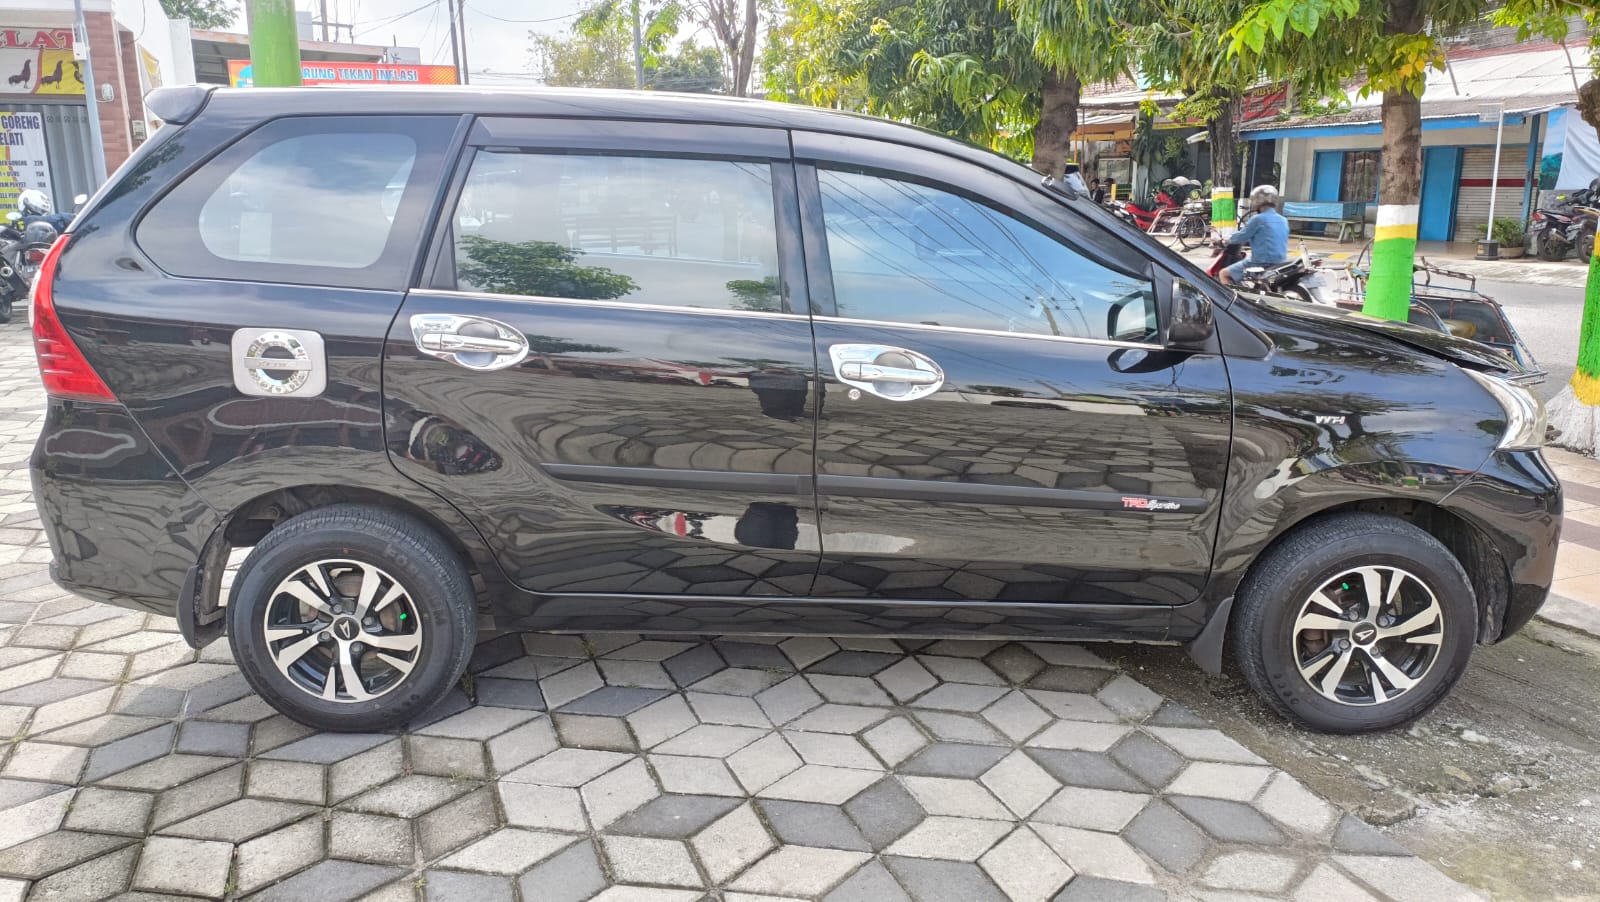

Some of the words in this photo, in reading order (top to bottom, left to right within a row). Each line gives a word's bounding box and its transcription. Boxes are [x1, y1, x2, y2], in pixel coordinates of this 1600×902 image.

[0, 29, 74, 49] LAT
[302, 67, 335, 80] RUNG
[338, 68, 373, 81] TEKAN
[376, 69, 418, 82] INFLASI
[1, 115, 40, 129] GORENG
[0, 132, 24, 146] ELATI
[1121, 497, 1148, 509] TRD
